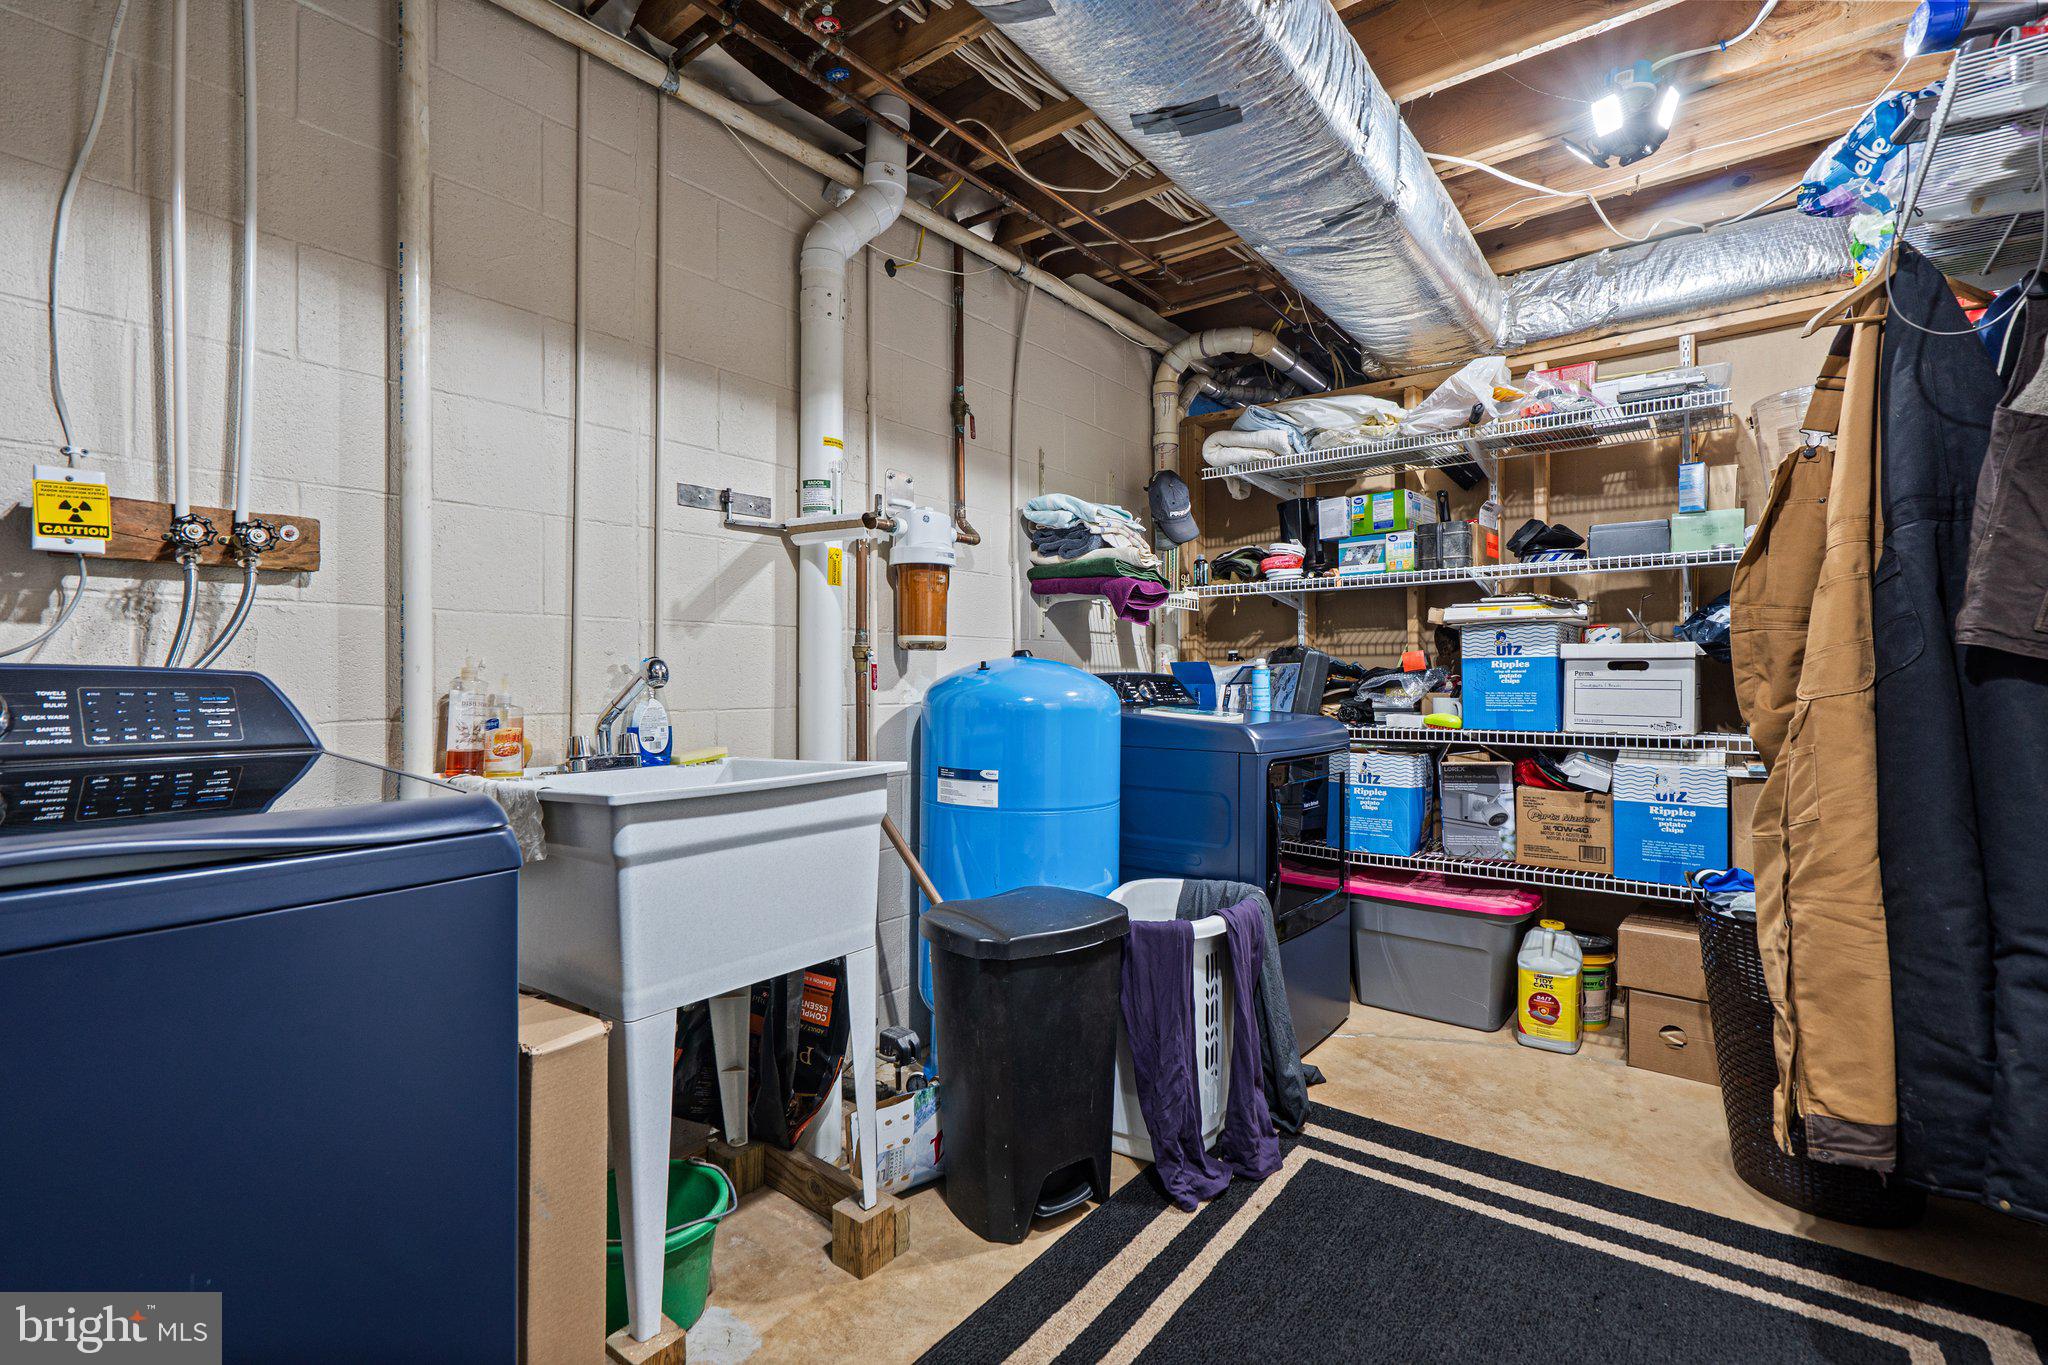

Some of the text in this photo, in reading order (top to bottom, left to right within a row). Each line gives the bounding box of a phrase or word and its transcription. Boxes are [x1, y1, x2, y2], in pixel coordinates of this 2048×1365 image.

[41, 524, 108, 536] CAUTION
[1491, 660, 1530, 669] Ripples
[25, 738, 73, 746] DRAIN+SPIN
[1353, 787, 1387, 796] Ripples
[1530, 810, 1560, 821] Parts
[1649, 806, 1697, 817] Ripples
[1552, 825, 1589, 833] 10W-40
